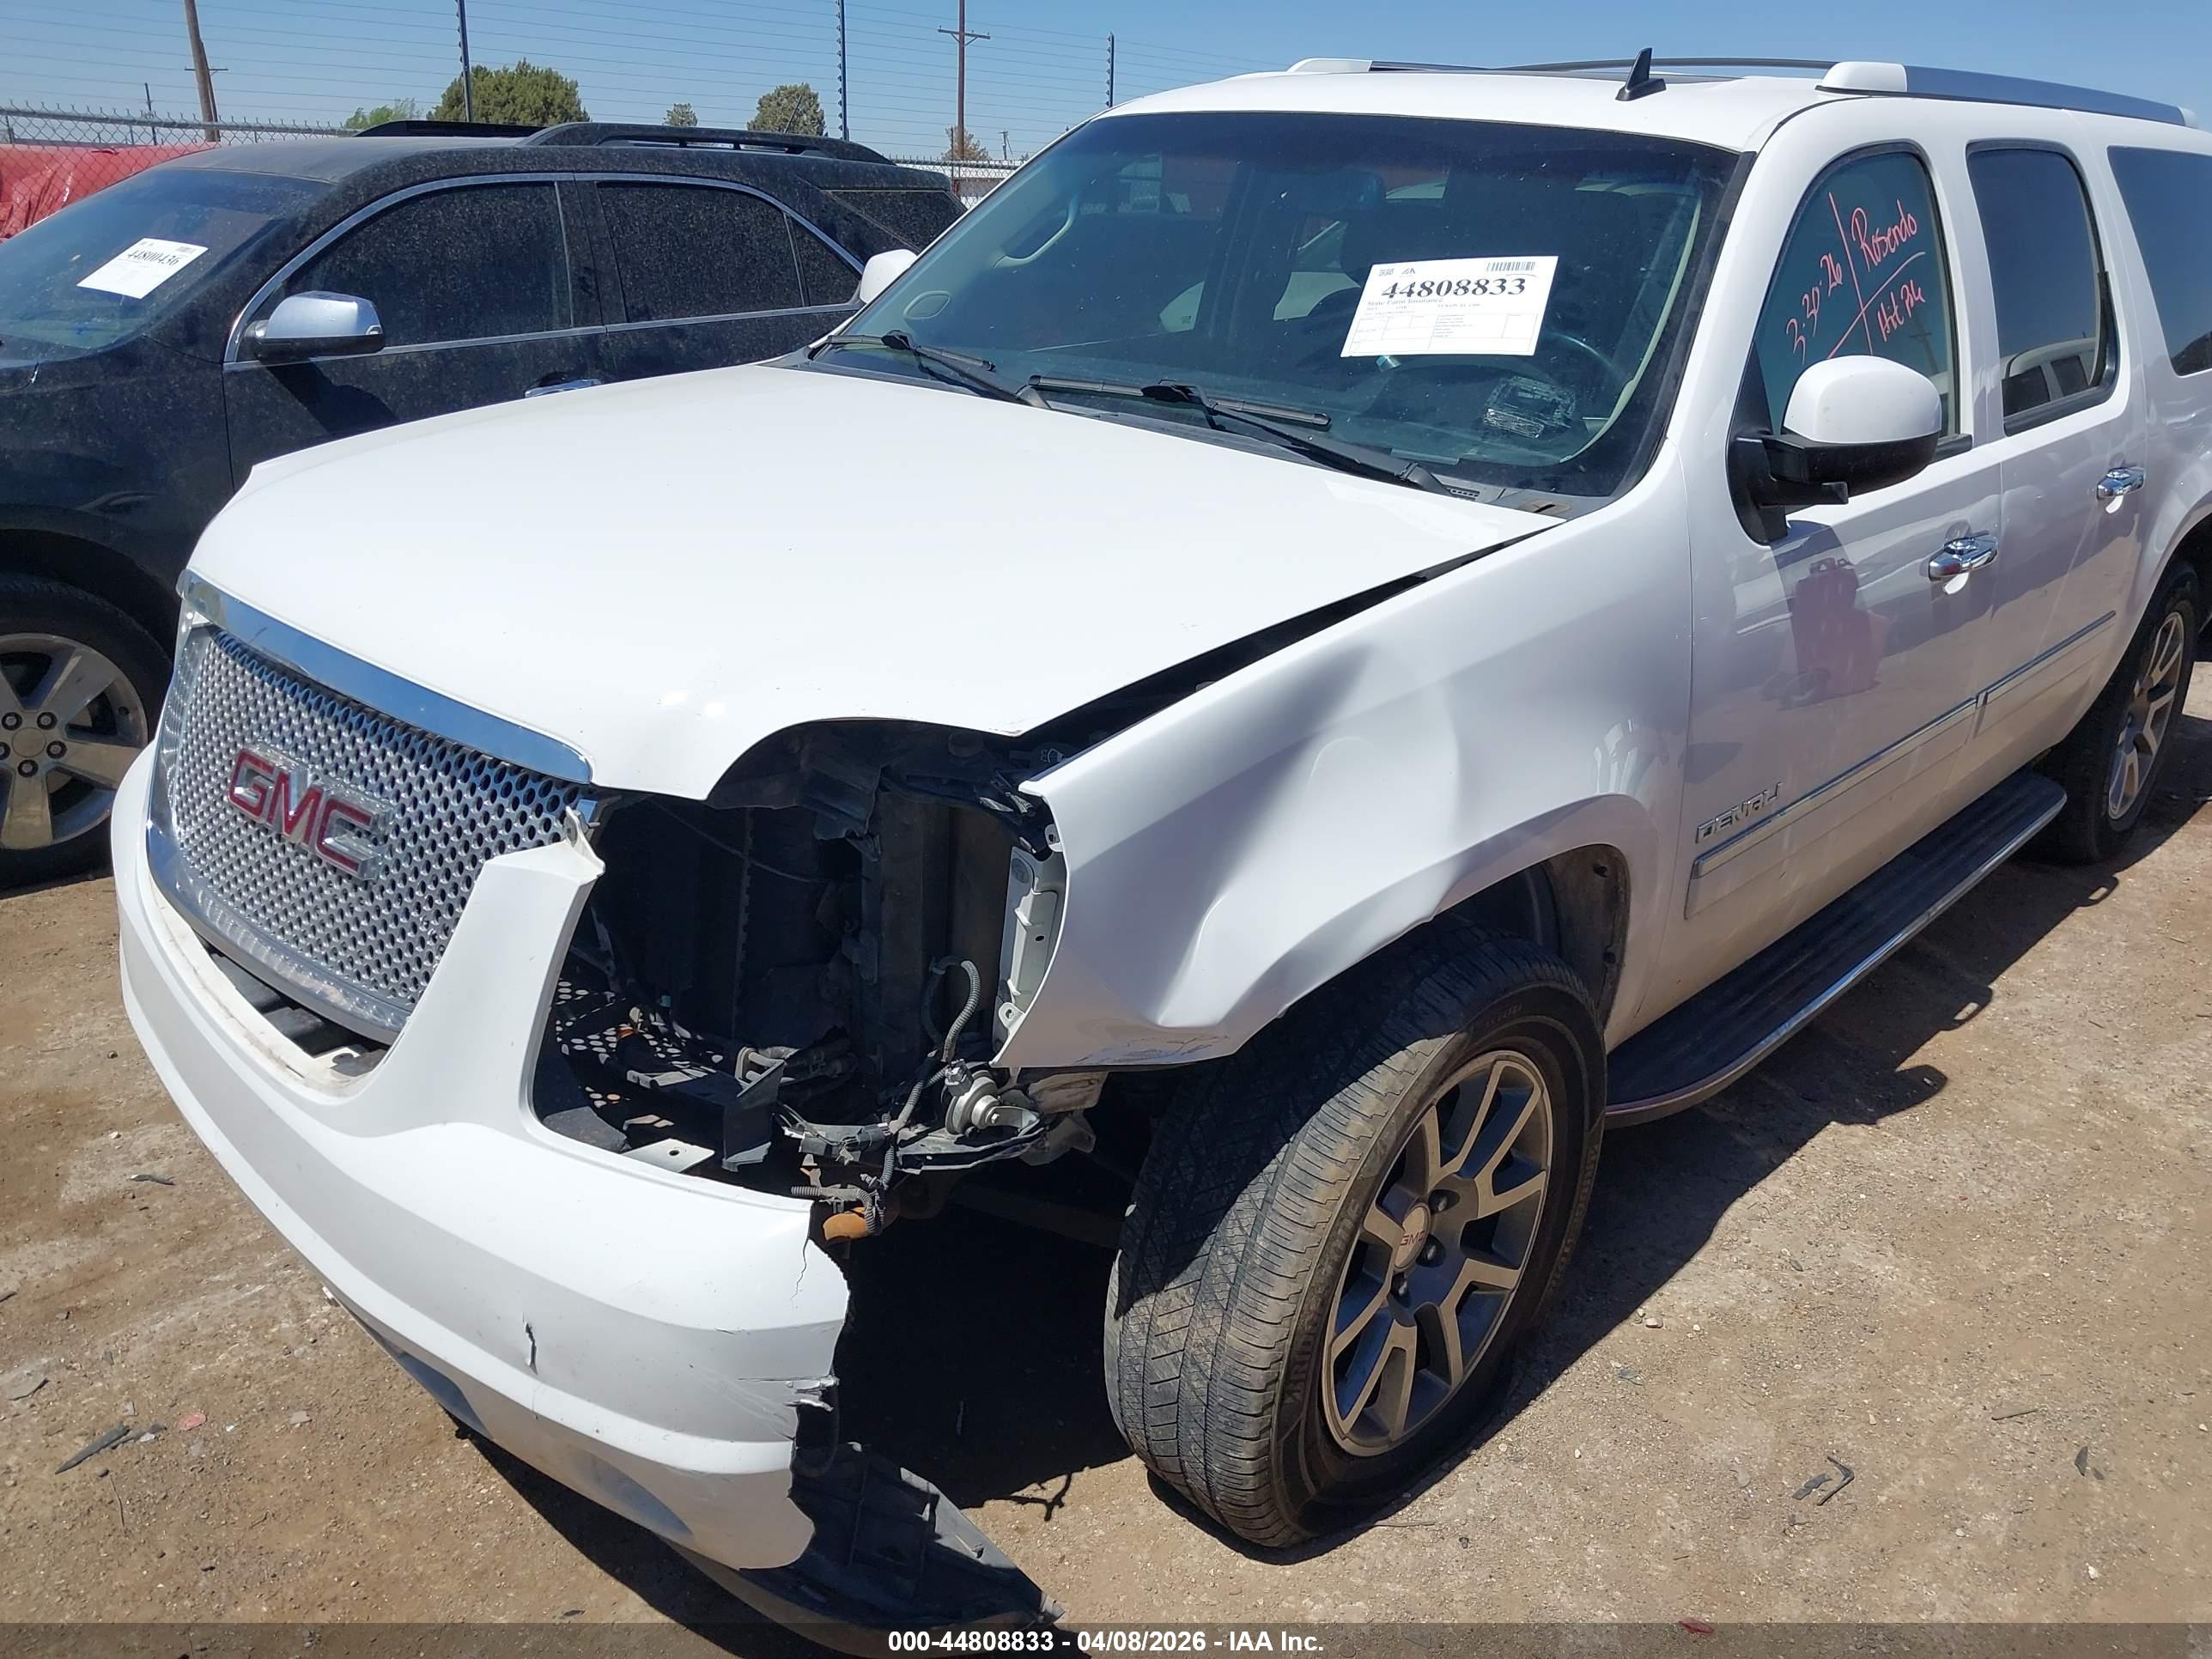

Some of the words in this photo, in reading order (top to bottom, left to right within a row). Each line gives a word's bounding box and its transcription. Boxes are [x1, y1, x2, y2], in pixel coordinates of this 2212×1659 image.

[1381, 278, 1526, 299] 44808833
[228, 746, 381, 880] GMC
[1694, 781, 1784, 844] DENALI
[1399, 1229, 1426, 1247] GMC
